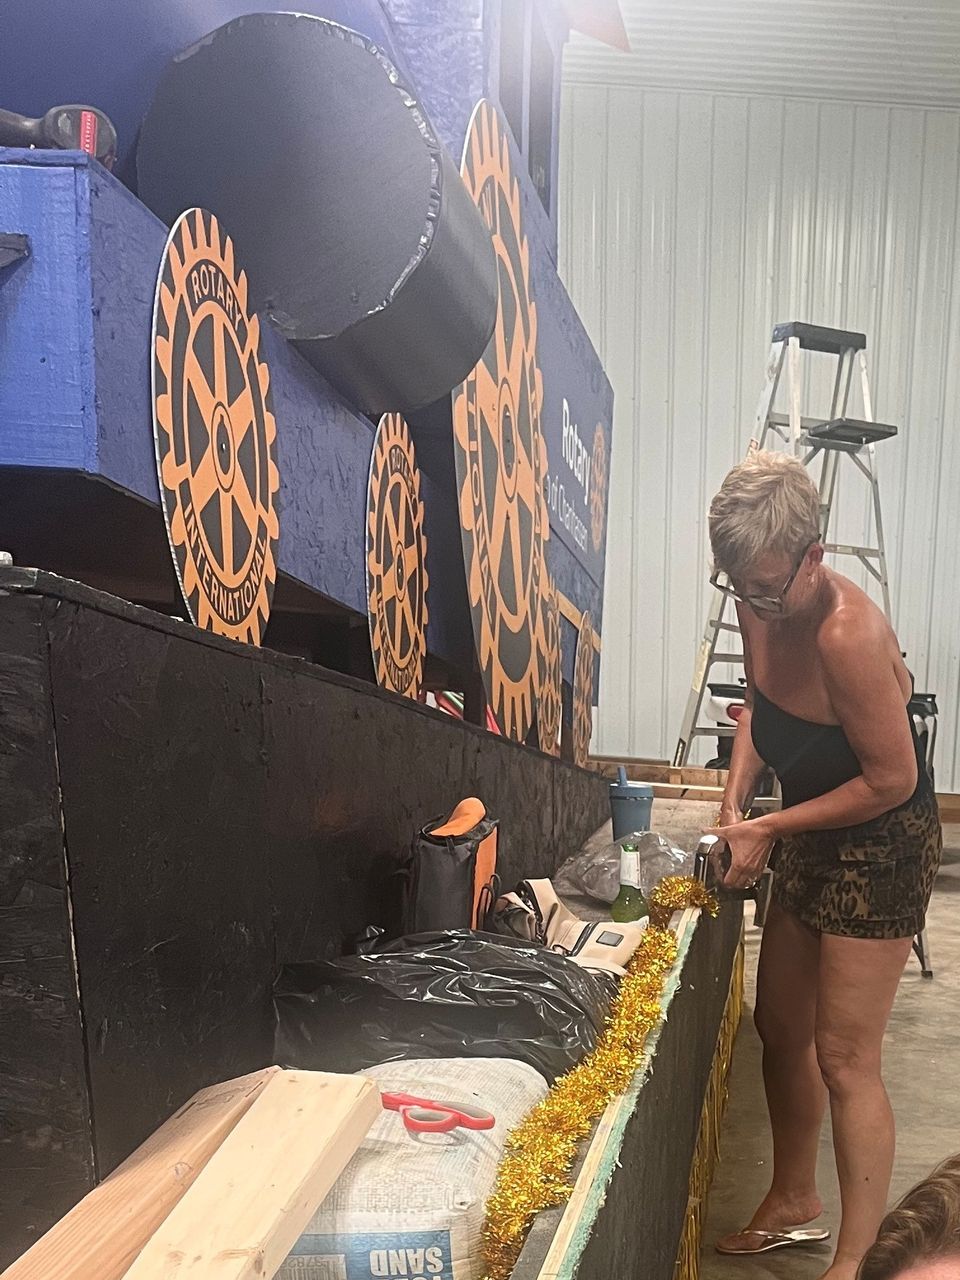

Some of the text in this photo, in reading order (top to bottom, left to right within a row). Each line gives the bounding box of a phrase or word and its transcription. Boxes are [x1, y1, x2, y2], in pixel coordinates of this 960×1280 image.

[191, 263, 243, 332] ROTARY
[562, 397, 591, 506] Rotary
[184, 502, 267, 622] INTERNATIONAL
[369, 1246, 444, 1277] SAND
